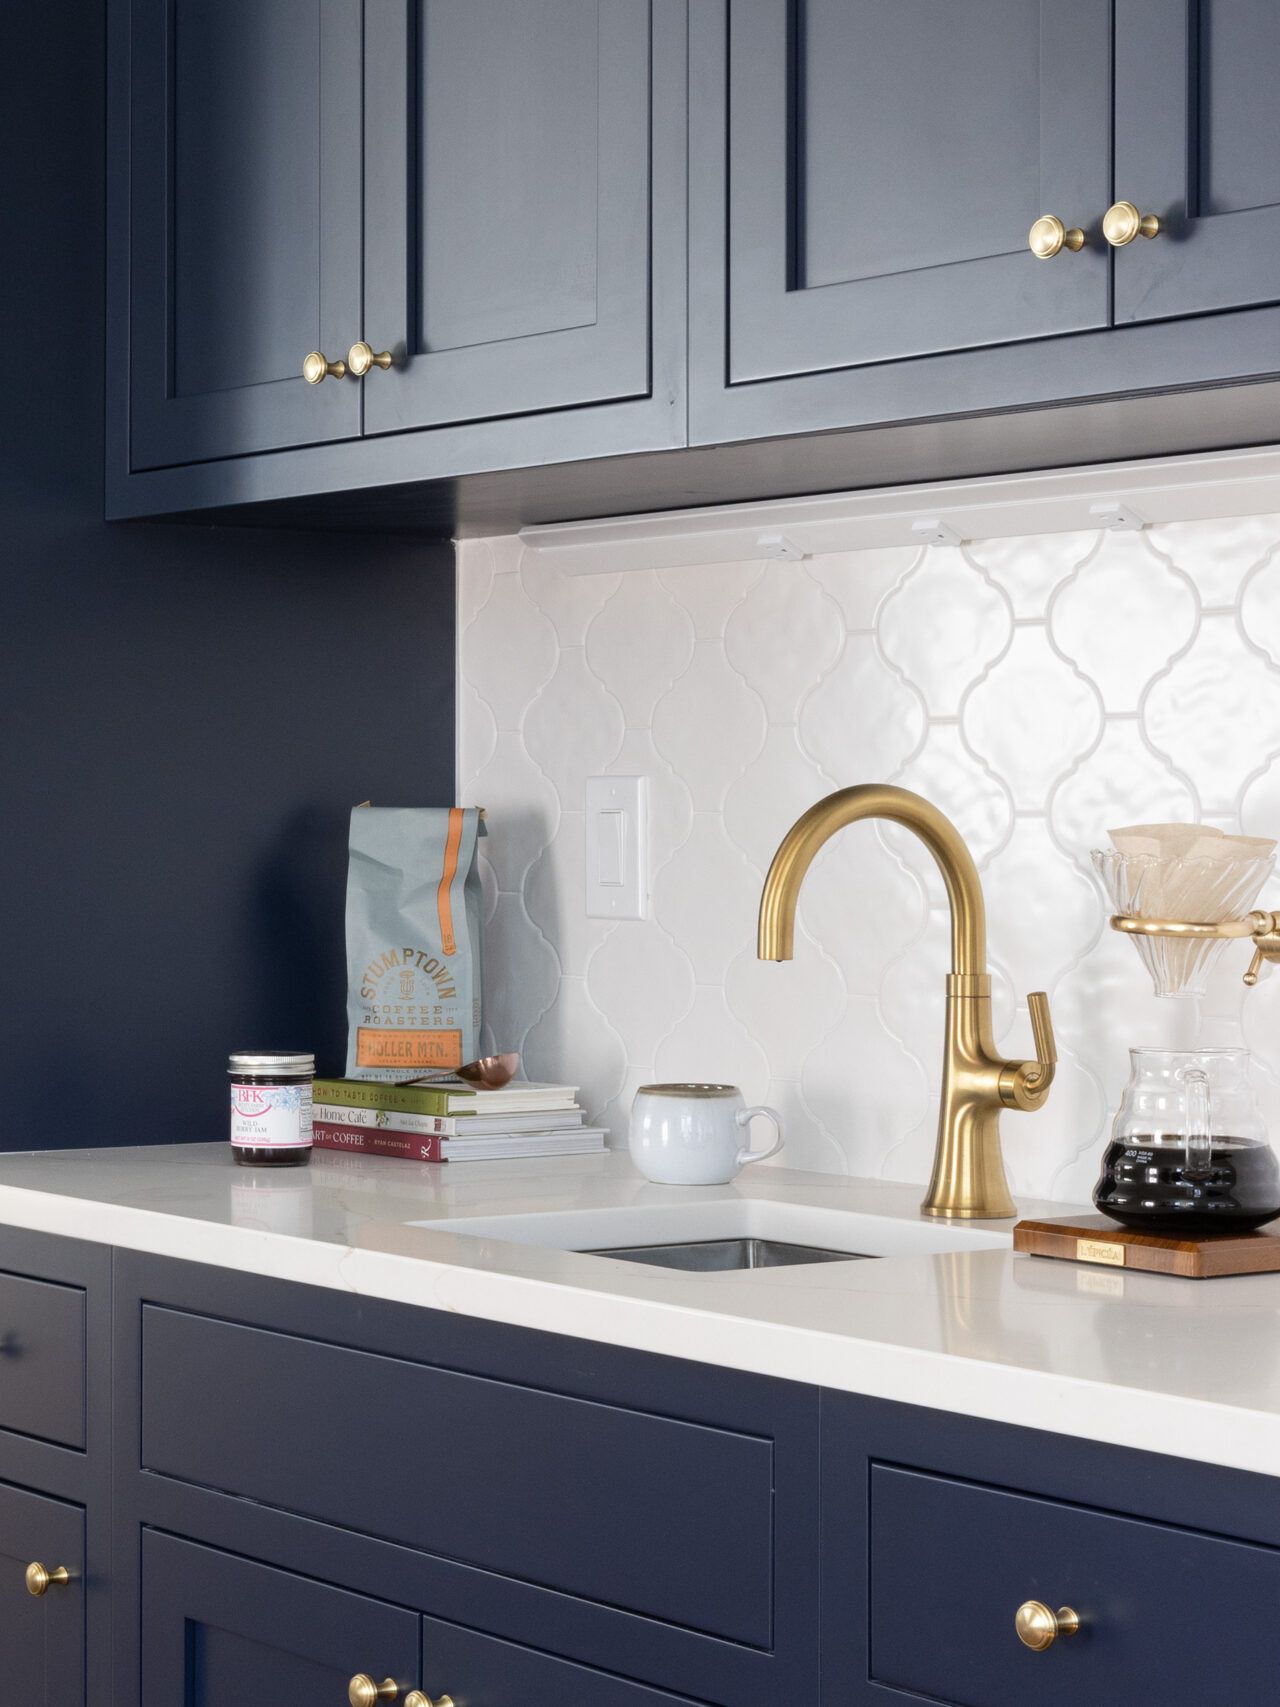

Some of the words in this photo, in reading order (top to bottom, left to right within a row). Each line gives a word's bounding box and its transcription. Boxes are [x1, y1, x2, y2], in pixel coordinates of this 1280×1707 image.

[360, 948, 457, 1000] STUMPTOWN
[372, 1005, 442, 1014] COFFEE
[363, 1015, 455, 1026] ROASTERS
[368, 1041, 413, 1057] HOLLER
[417, 1041, 448, 1058] MTN.
[312, 1087, 327, 1096] HOW
[331, 1089, 340, 1098] TO
[343, 1090, 366, 1101] TASTE
[369, 1093, 398, 1104] COFFEE
[320, 1107, 346, 1122] Home
[347, 1109, 367, 1124] Café
[332, 1131, 365, 1146] COFFEE
